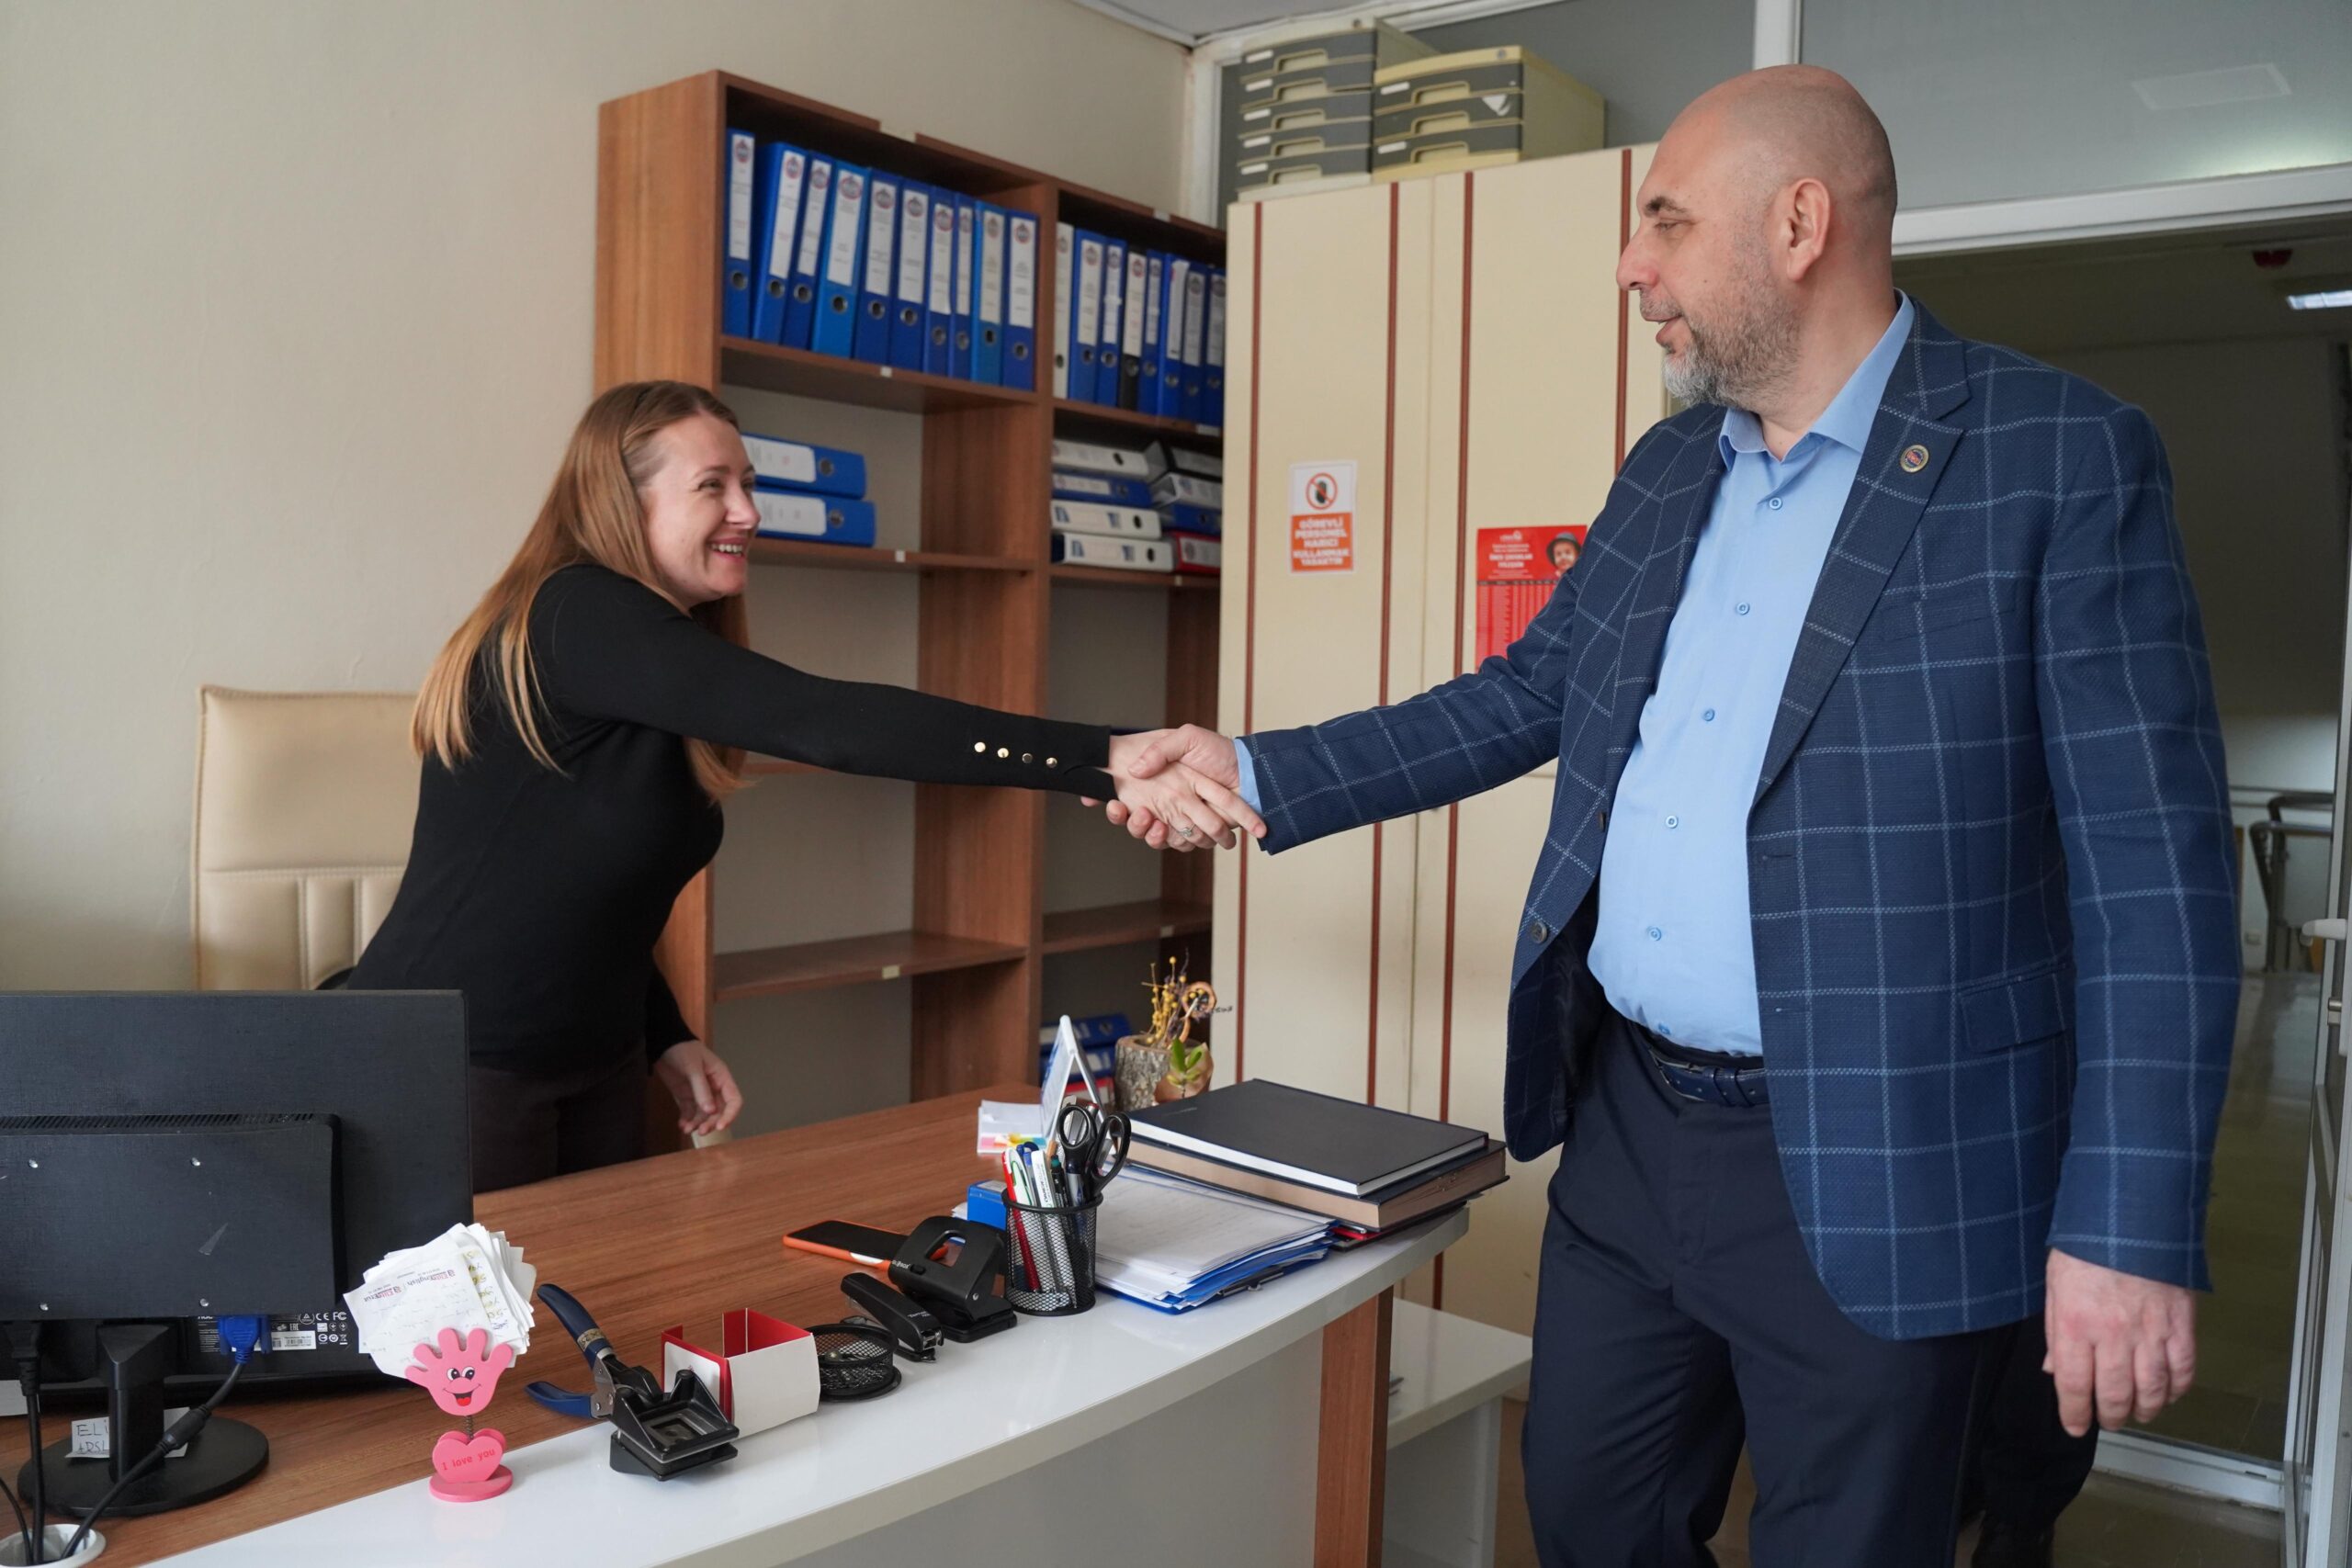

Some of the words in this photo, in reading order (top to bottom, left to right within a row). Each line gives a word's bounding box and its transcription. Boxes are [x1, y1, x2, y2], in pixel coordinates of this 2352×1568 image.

[442, 1462, 448, 1471] I
[452, 1456, 472, 1467] love
[478, 1449, 495, 1461] you
